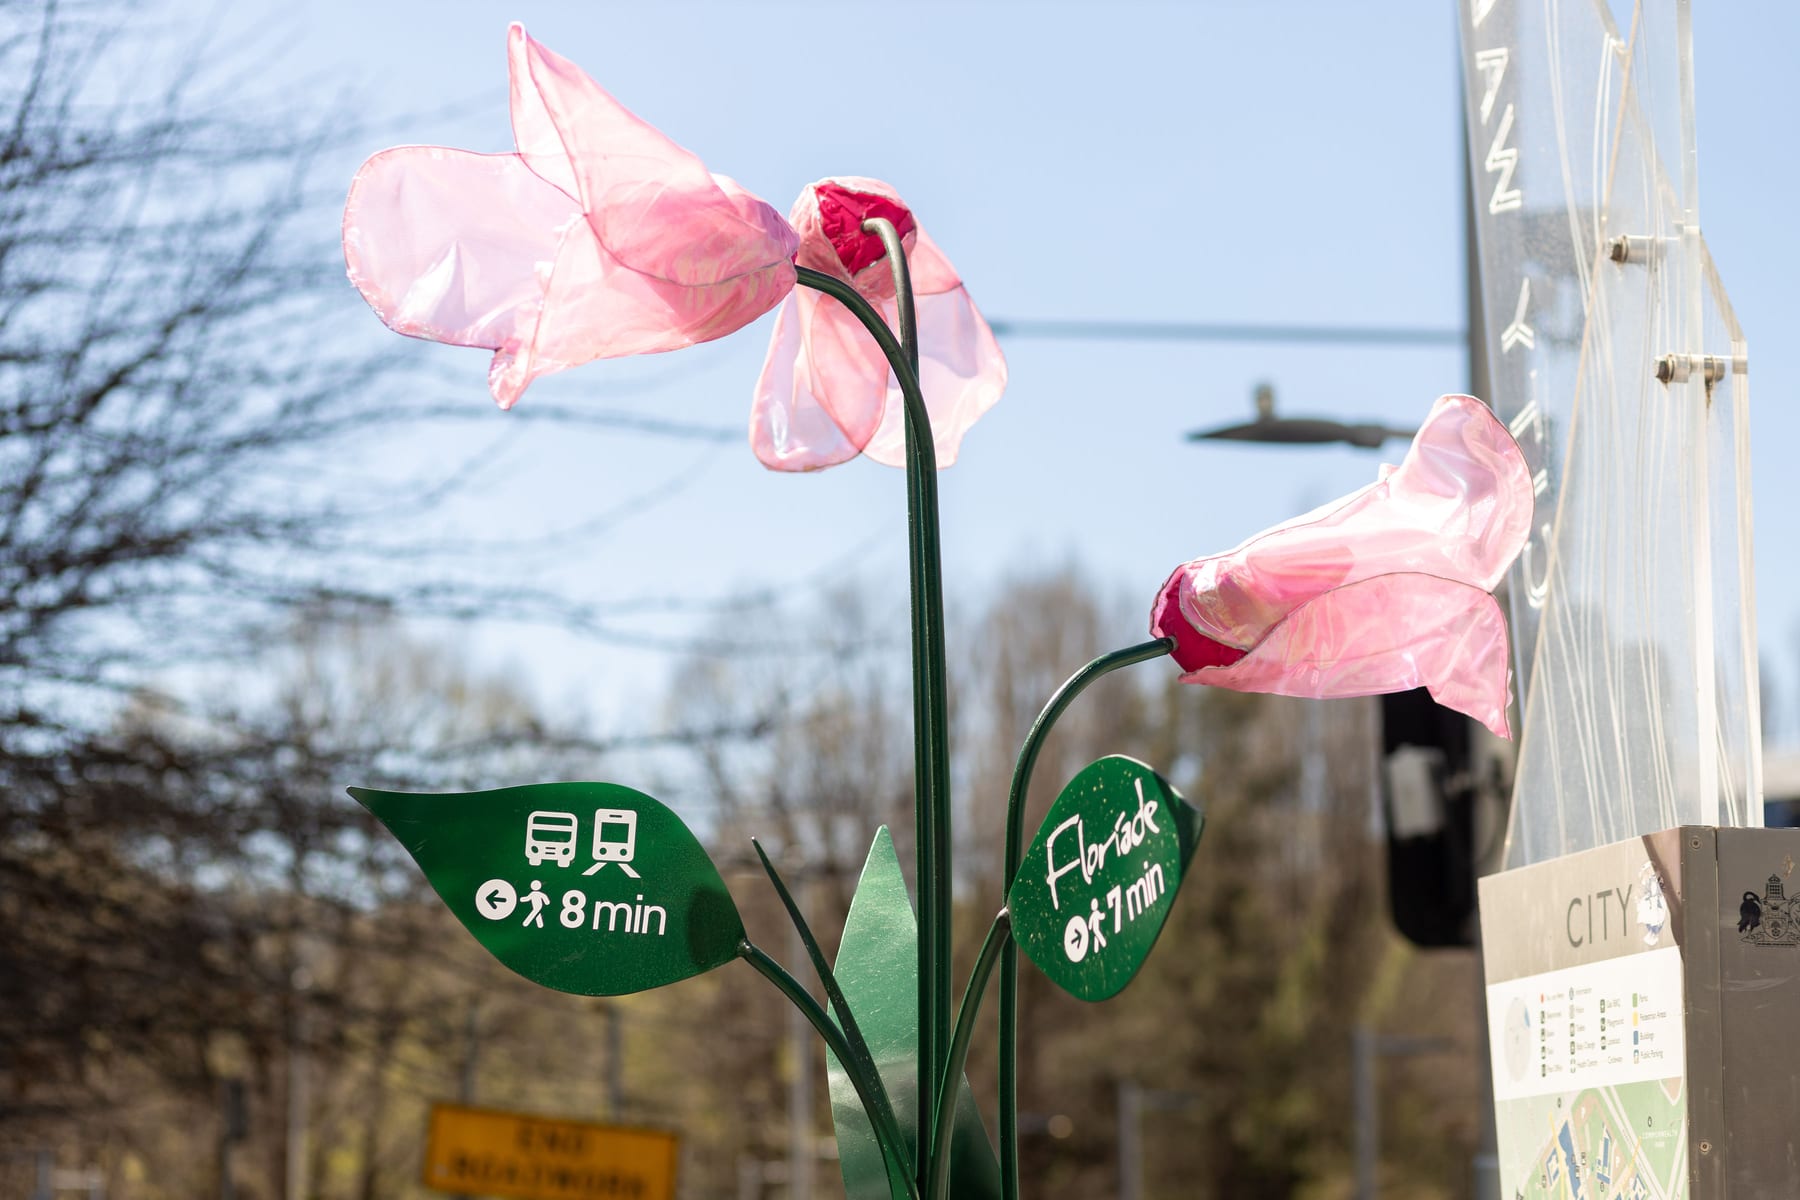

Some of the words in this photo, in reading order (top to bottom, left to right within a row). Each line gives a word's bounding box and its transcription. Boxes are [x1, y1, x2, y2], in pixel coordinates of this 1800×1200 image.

[1046, 777, 1160, 910] Floriade
[559, 889, 587, 929] 8
[592, 894, 667, 936] min
[1106, 884, 1122, 934] 7
[1126, 860, 1165, 921] min
[1566, 883, 1633, 948] CITY
